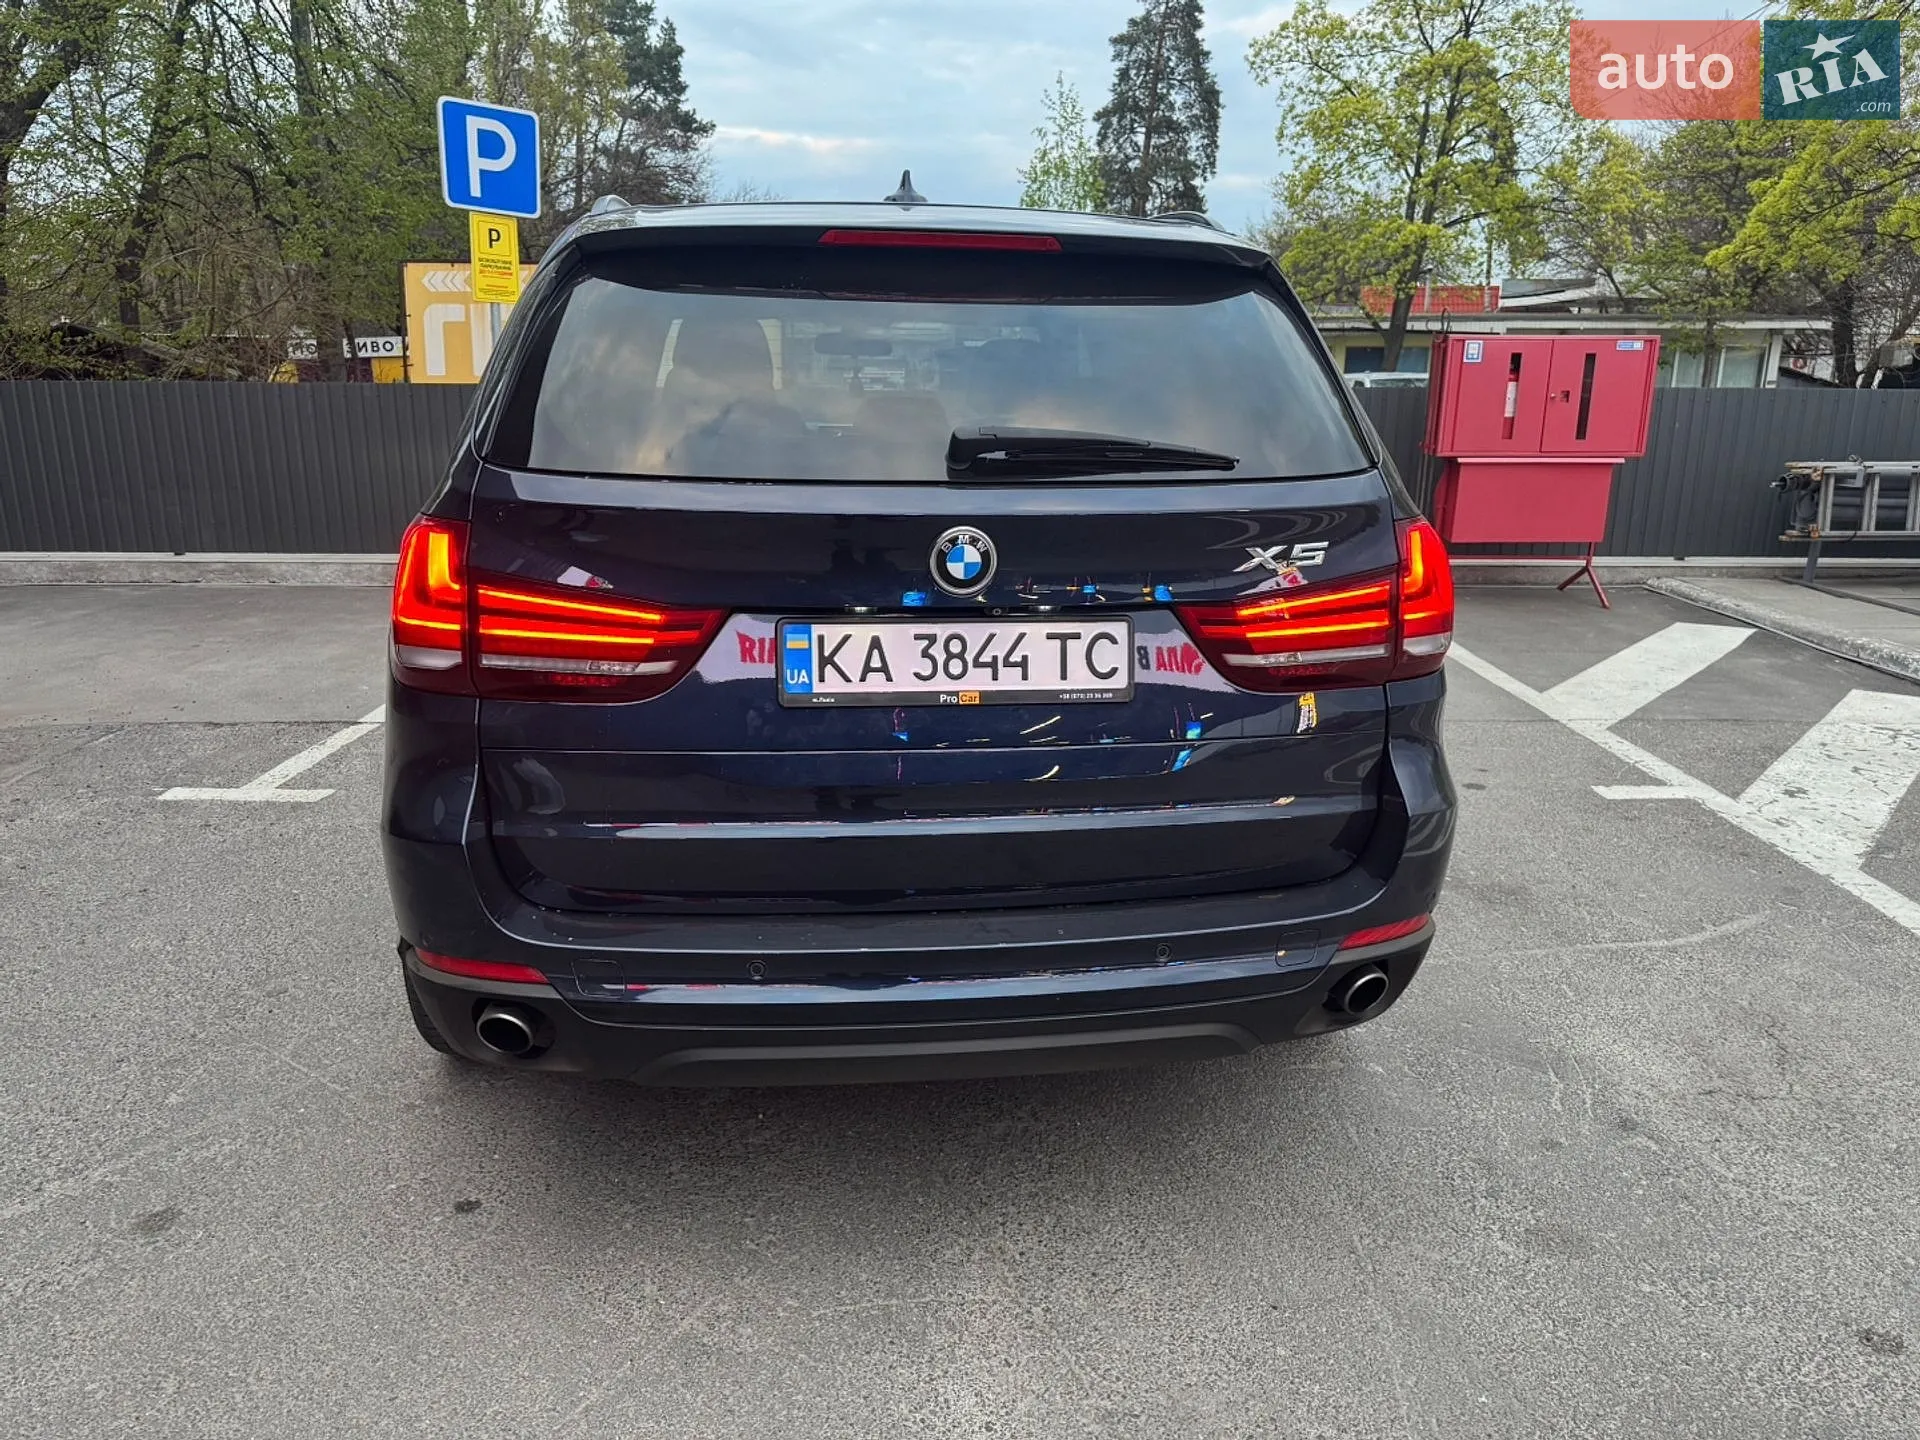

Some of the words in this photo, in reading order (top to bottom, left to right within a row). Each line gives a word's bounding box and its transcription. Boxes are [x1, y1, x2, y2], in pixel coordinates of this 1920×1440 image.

[465, 115, 517, 198] P
[488, 228, 501, 249] P
[941, 534, 989, 553] BMW
[1232, 541, 1330, 576] X5
[817, 633, 894, 683] KA
[913, 632, 1030, 682] 3844
[1046, 632, 1120, 681] TC
[786, 669, 809, 684] UA
